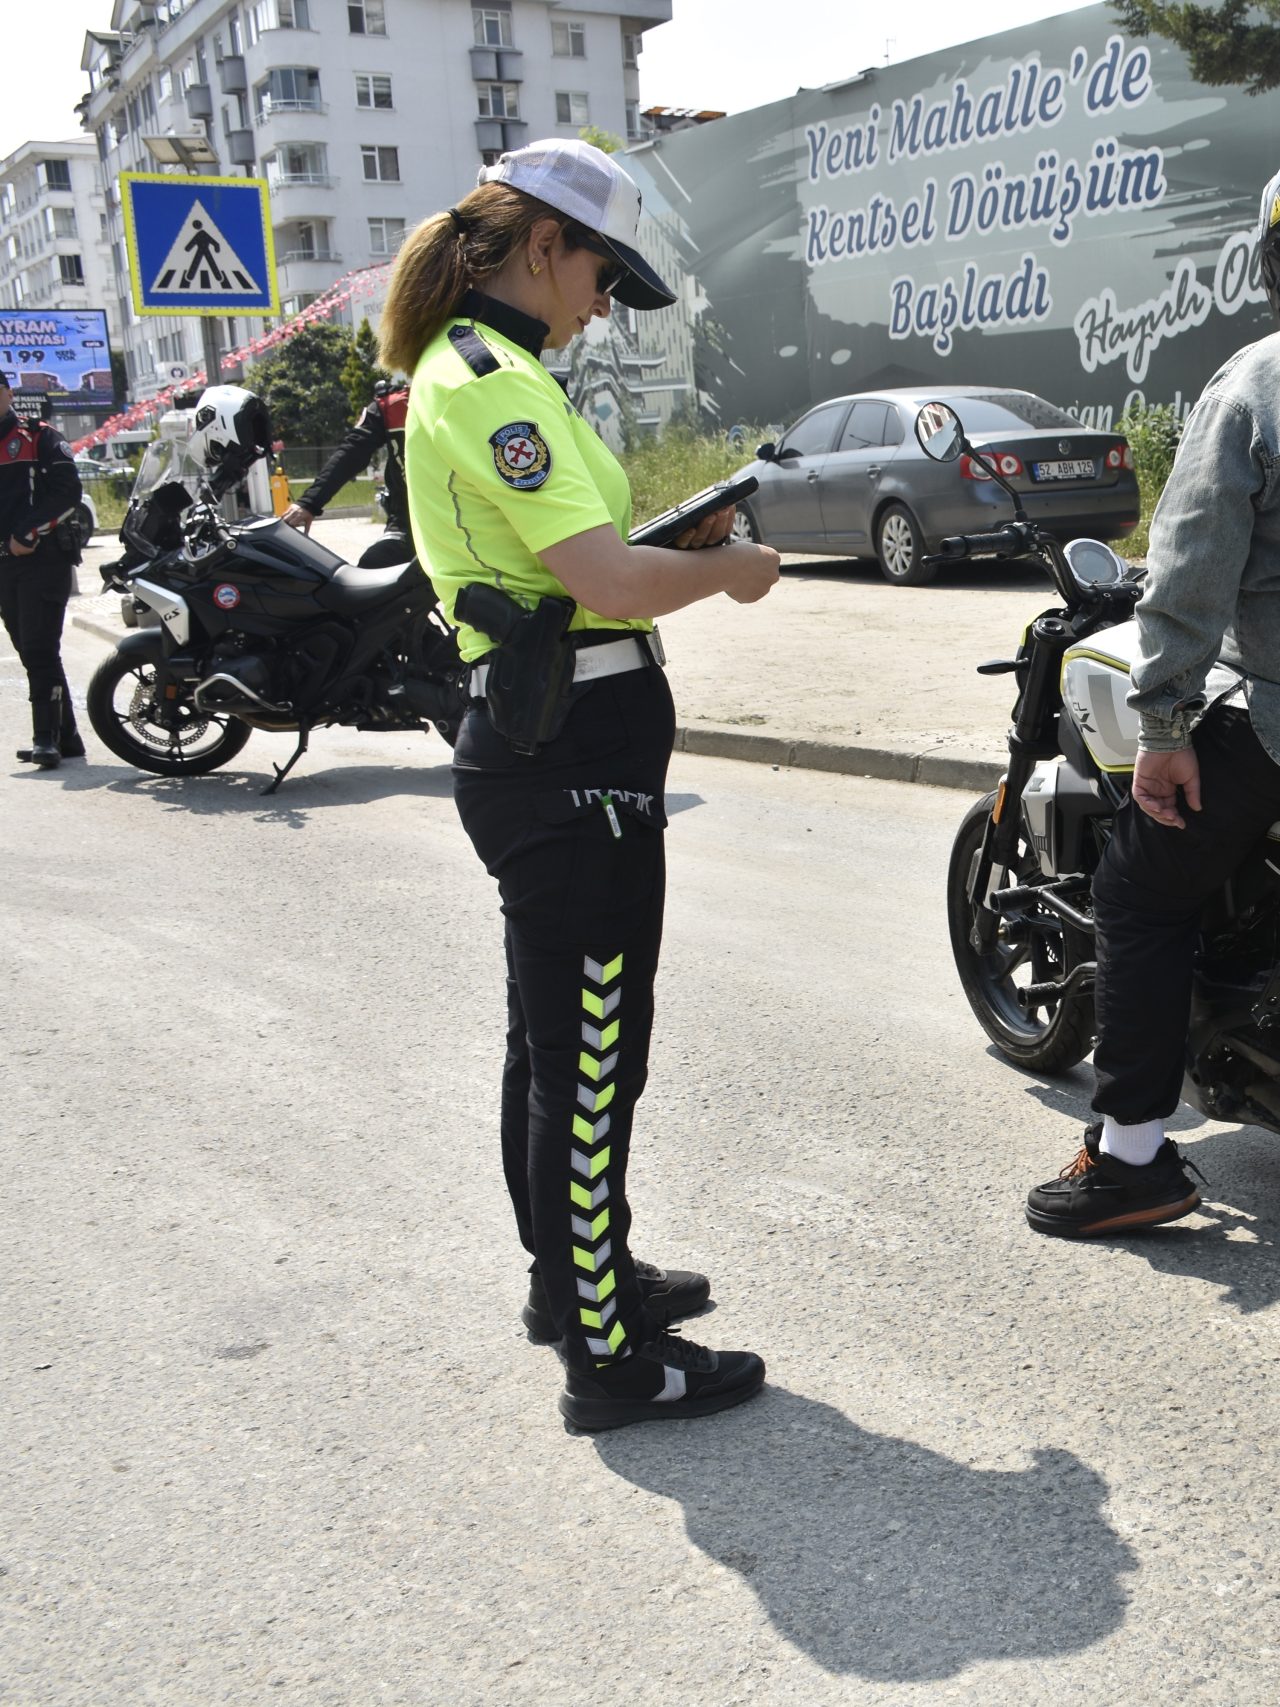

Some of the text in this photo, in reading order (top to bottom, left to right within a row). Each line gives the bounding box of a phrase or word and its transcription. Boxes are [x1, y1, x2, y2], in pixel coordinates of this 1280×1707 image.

[806, 41, 1152, 179] Yeni Mahalle'de
[806, 142, 1164, 261] Kentsel Dönüşüm
[891, 258, 1051, 350] Başladı
[1039, 460, 1094, 476] 52 ABH 125
[163, 608, 181, 622] GS
